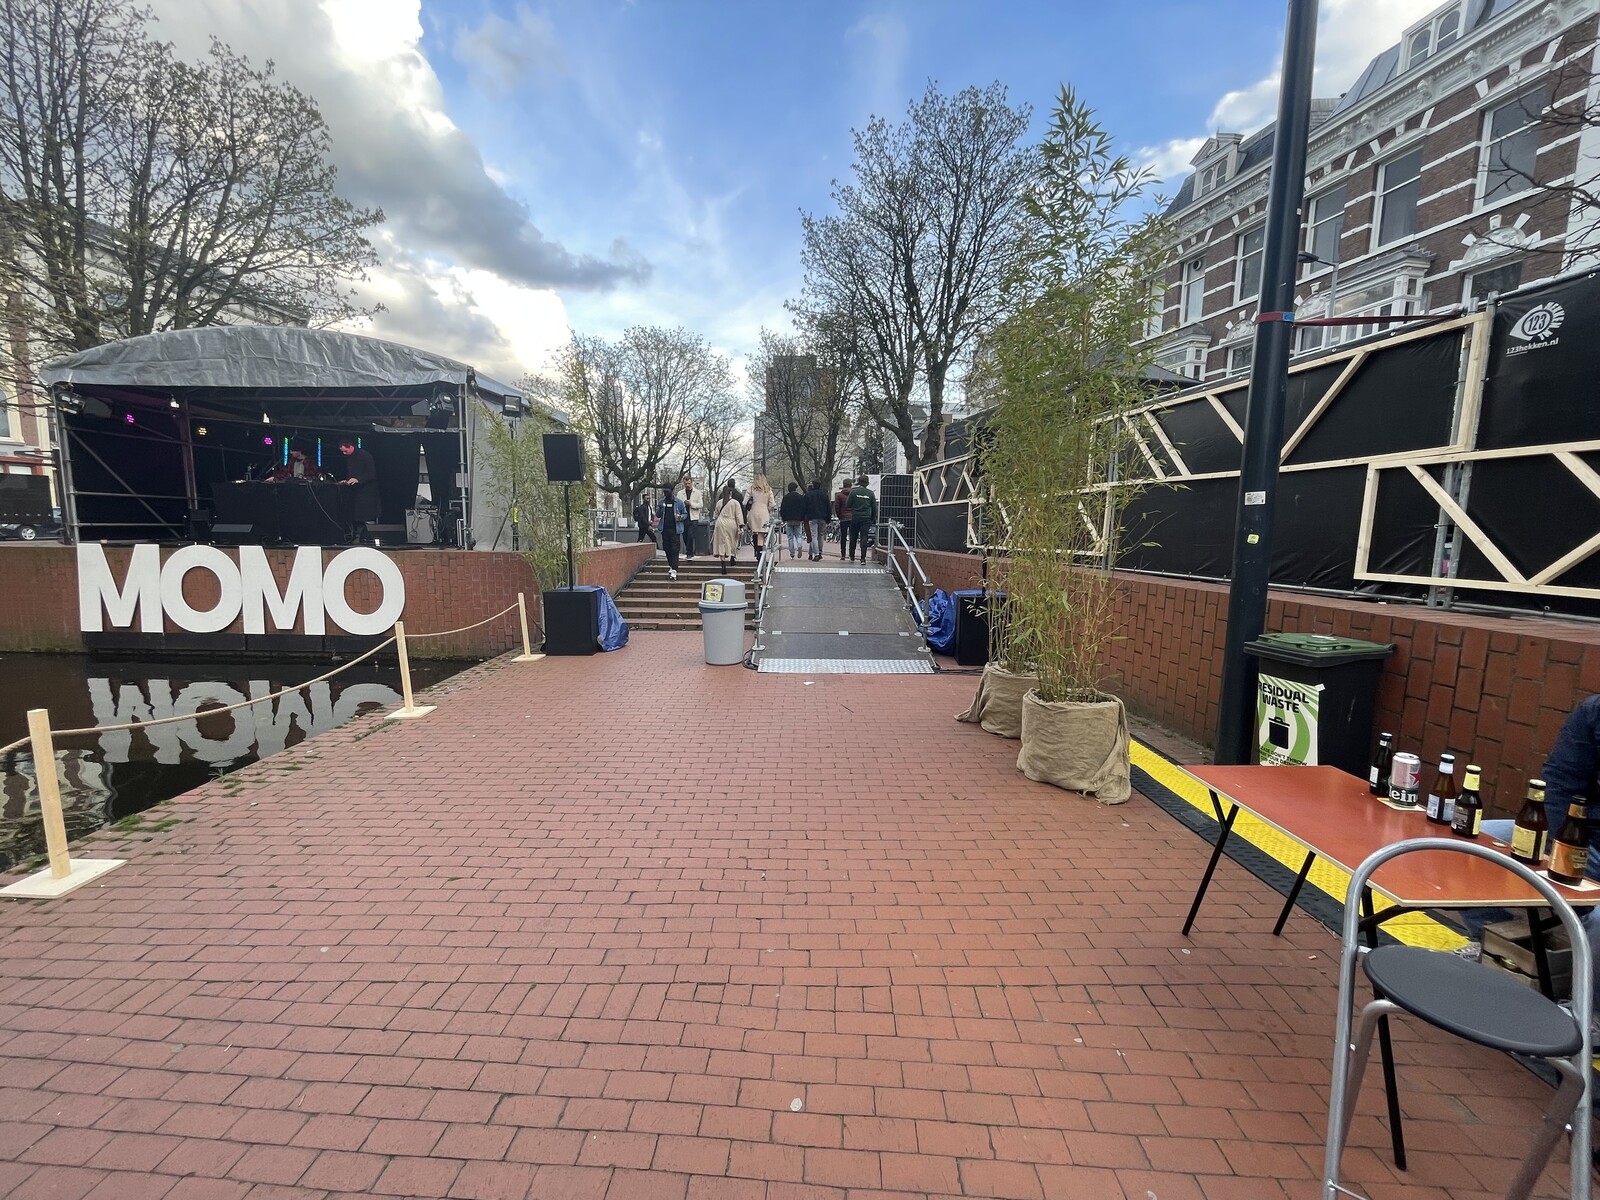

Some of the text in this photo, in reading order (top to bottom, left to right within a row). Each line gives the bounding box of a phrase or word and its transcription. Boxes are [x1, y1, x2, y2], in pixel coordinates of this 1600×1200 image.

[1527, 313, 1547, 332] 123
[1506, 337, 1559, 355] 123hekken.nl
[77, 543, 405, 636] MOMO
[1258, 681, 1309, 704] RESIDUAL
[1262, 693, 1300, 713] WASTE
